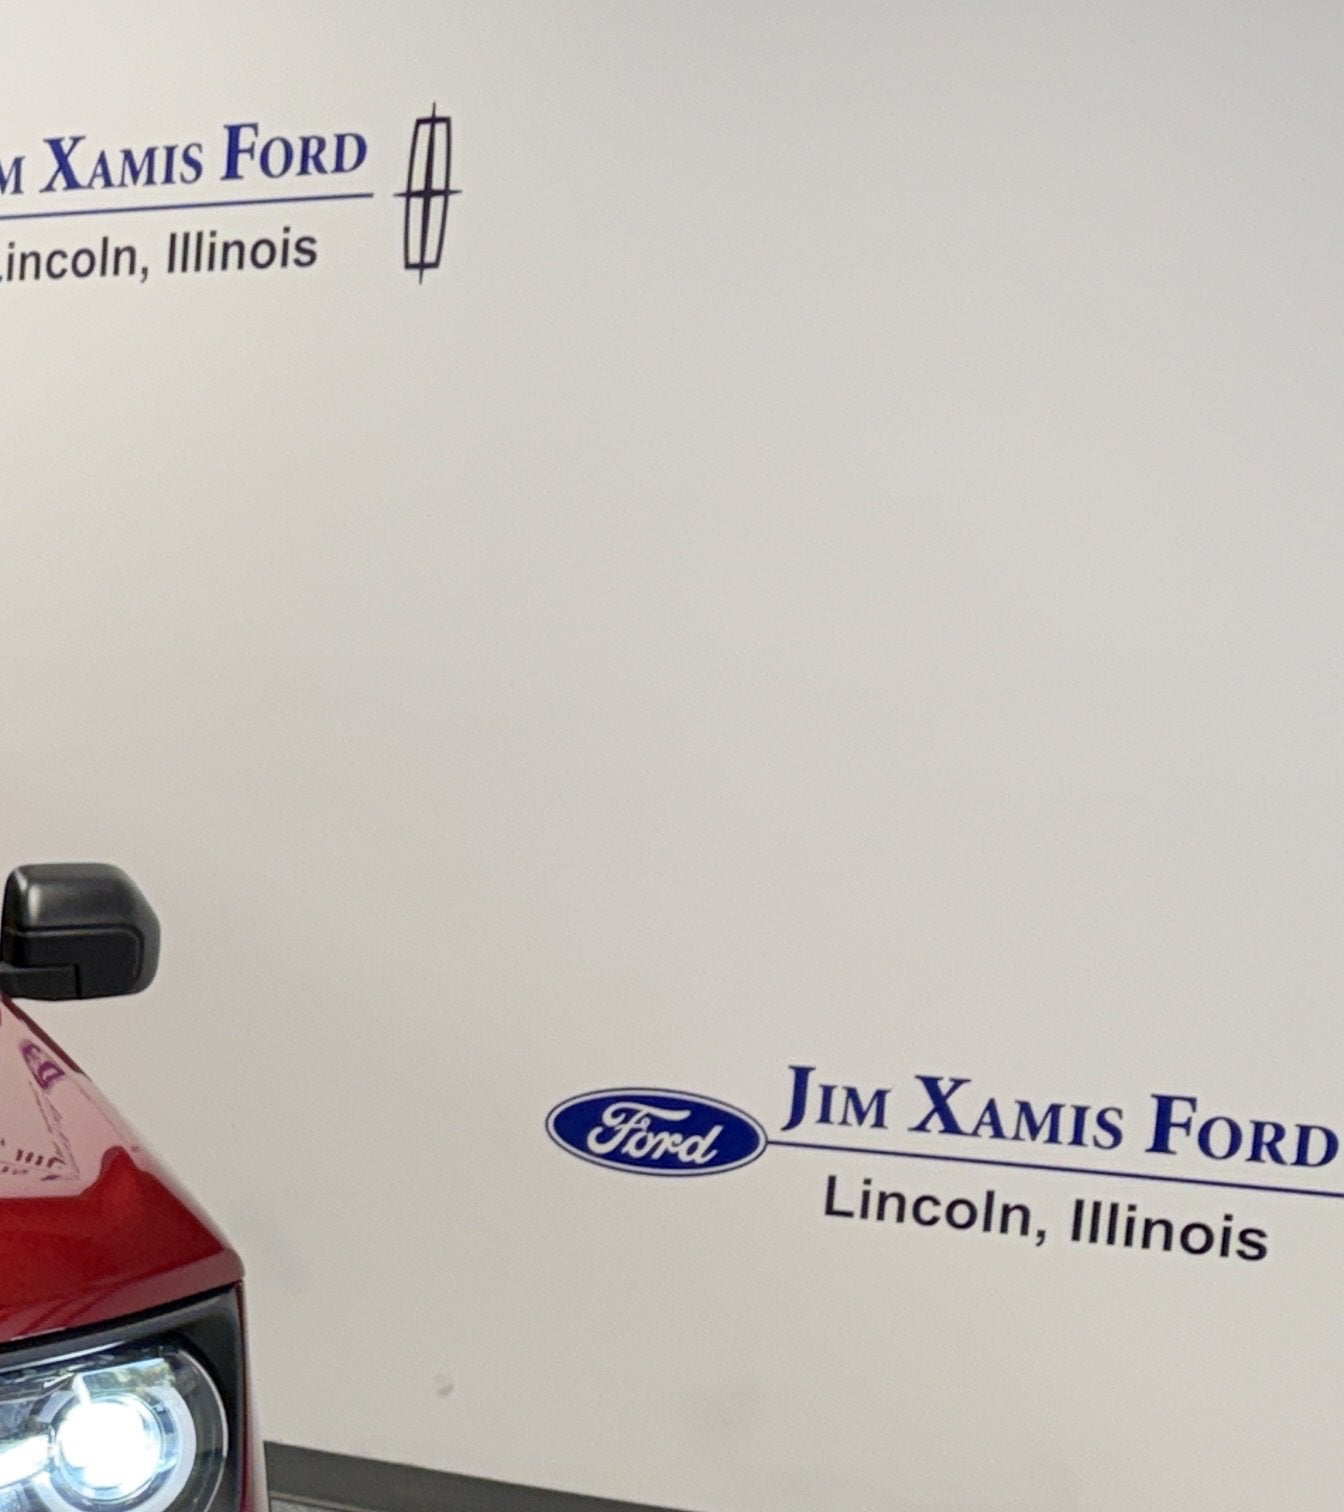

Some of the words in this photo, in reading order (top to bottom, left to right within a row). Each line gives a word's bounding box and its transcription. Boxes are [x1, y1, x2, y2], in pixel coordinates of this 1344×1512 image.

[39, 136, 203, 193] XAMIS
[221, 123, 367, 180] FORD
[168, 226, 317, 273] Illinois
[586, 1102, 719, 1166] Ford
[781, 1065, 890, 1131] JIM
[913, 1075, 1123, 1150] XAMIS
[1145, 1094, 1339, 1167] FORD
[824, 1175, 1048, 1246] Lincoln,
[1071, 1199, 1267, 1261] Illinois
